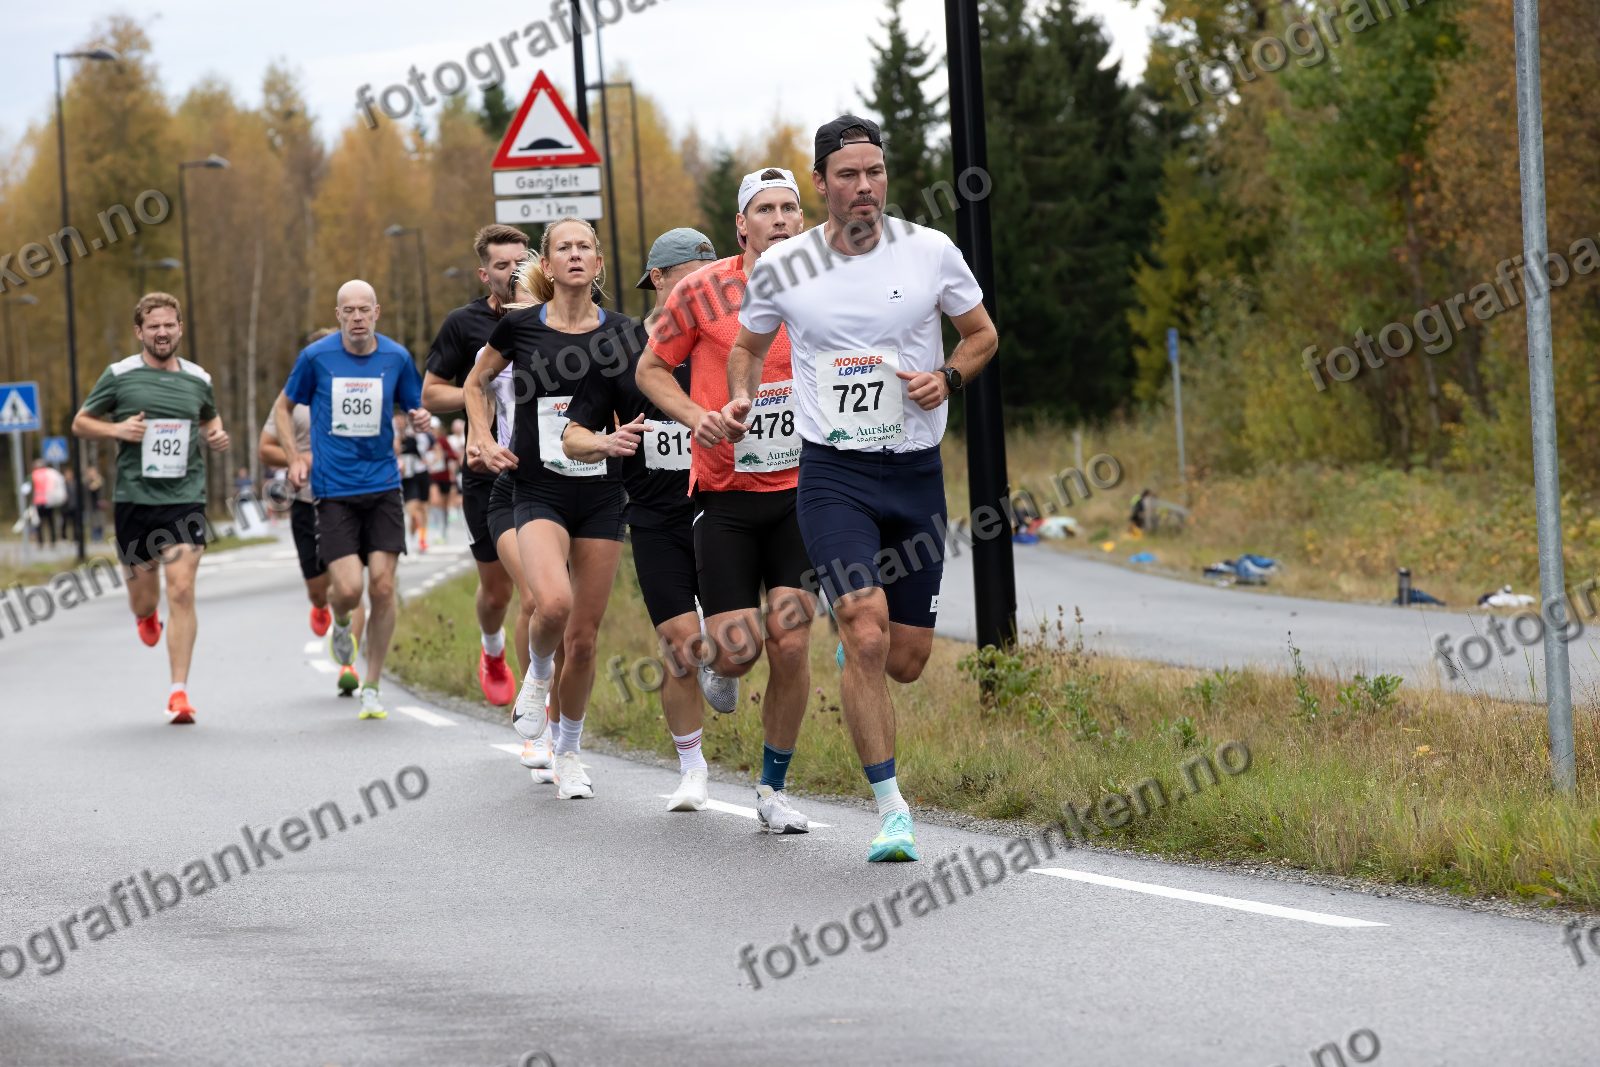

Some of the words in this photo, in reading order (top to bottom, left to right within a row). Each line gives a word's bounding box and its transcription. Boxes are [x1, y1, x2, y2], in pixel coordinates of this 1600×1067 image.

[516, 174, 580, 191] Gangfelt
[832, 355, 883, 368] NORGES
[838, 364, 876, 377] LØPET
[755, 395, 789, 407] LØPET
[832, 380, 884, 414] 727
[342, 398, 372, 415] 636
[749, 410, 795, 440] 478
[856, 422, 902, 436] Aurskog
[151, 438, 181, 456] 492
[766, 447, 802, 460] Aursko
